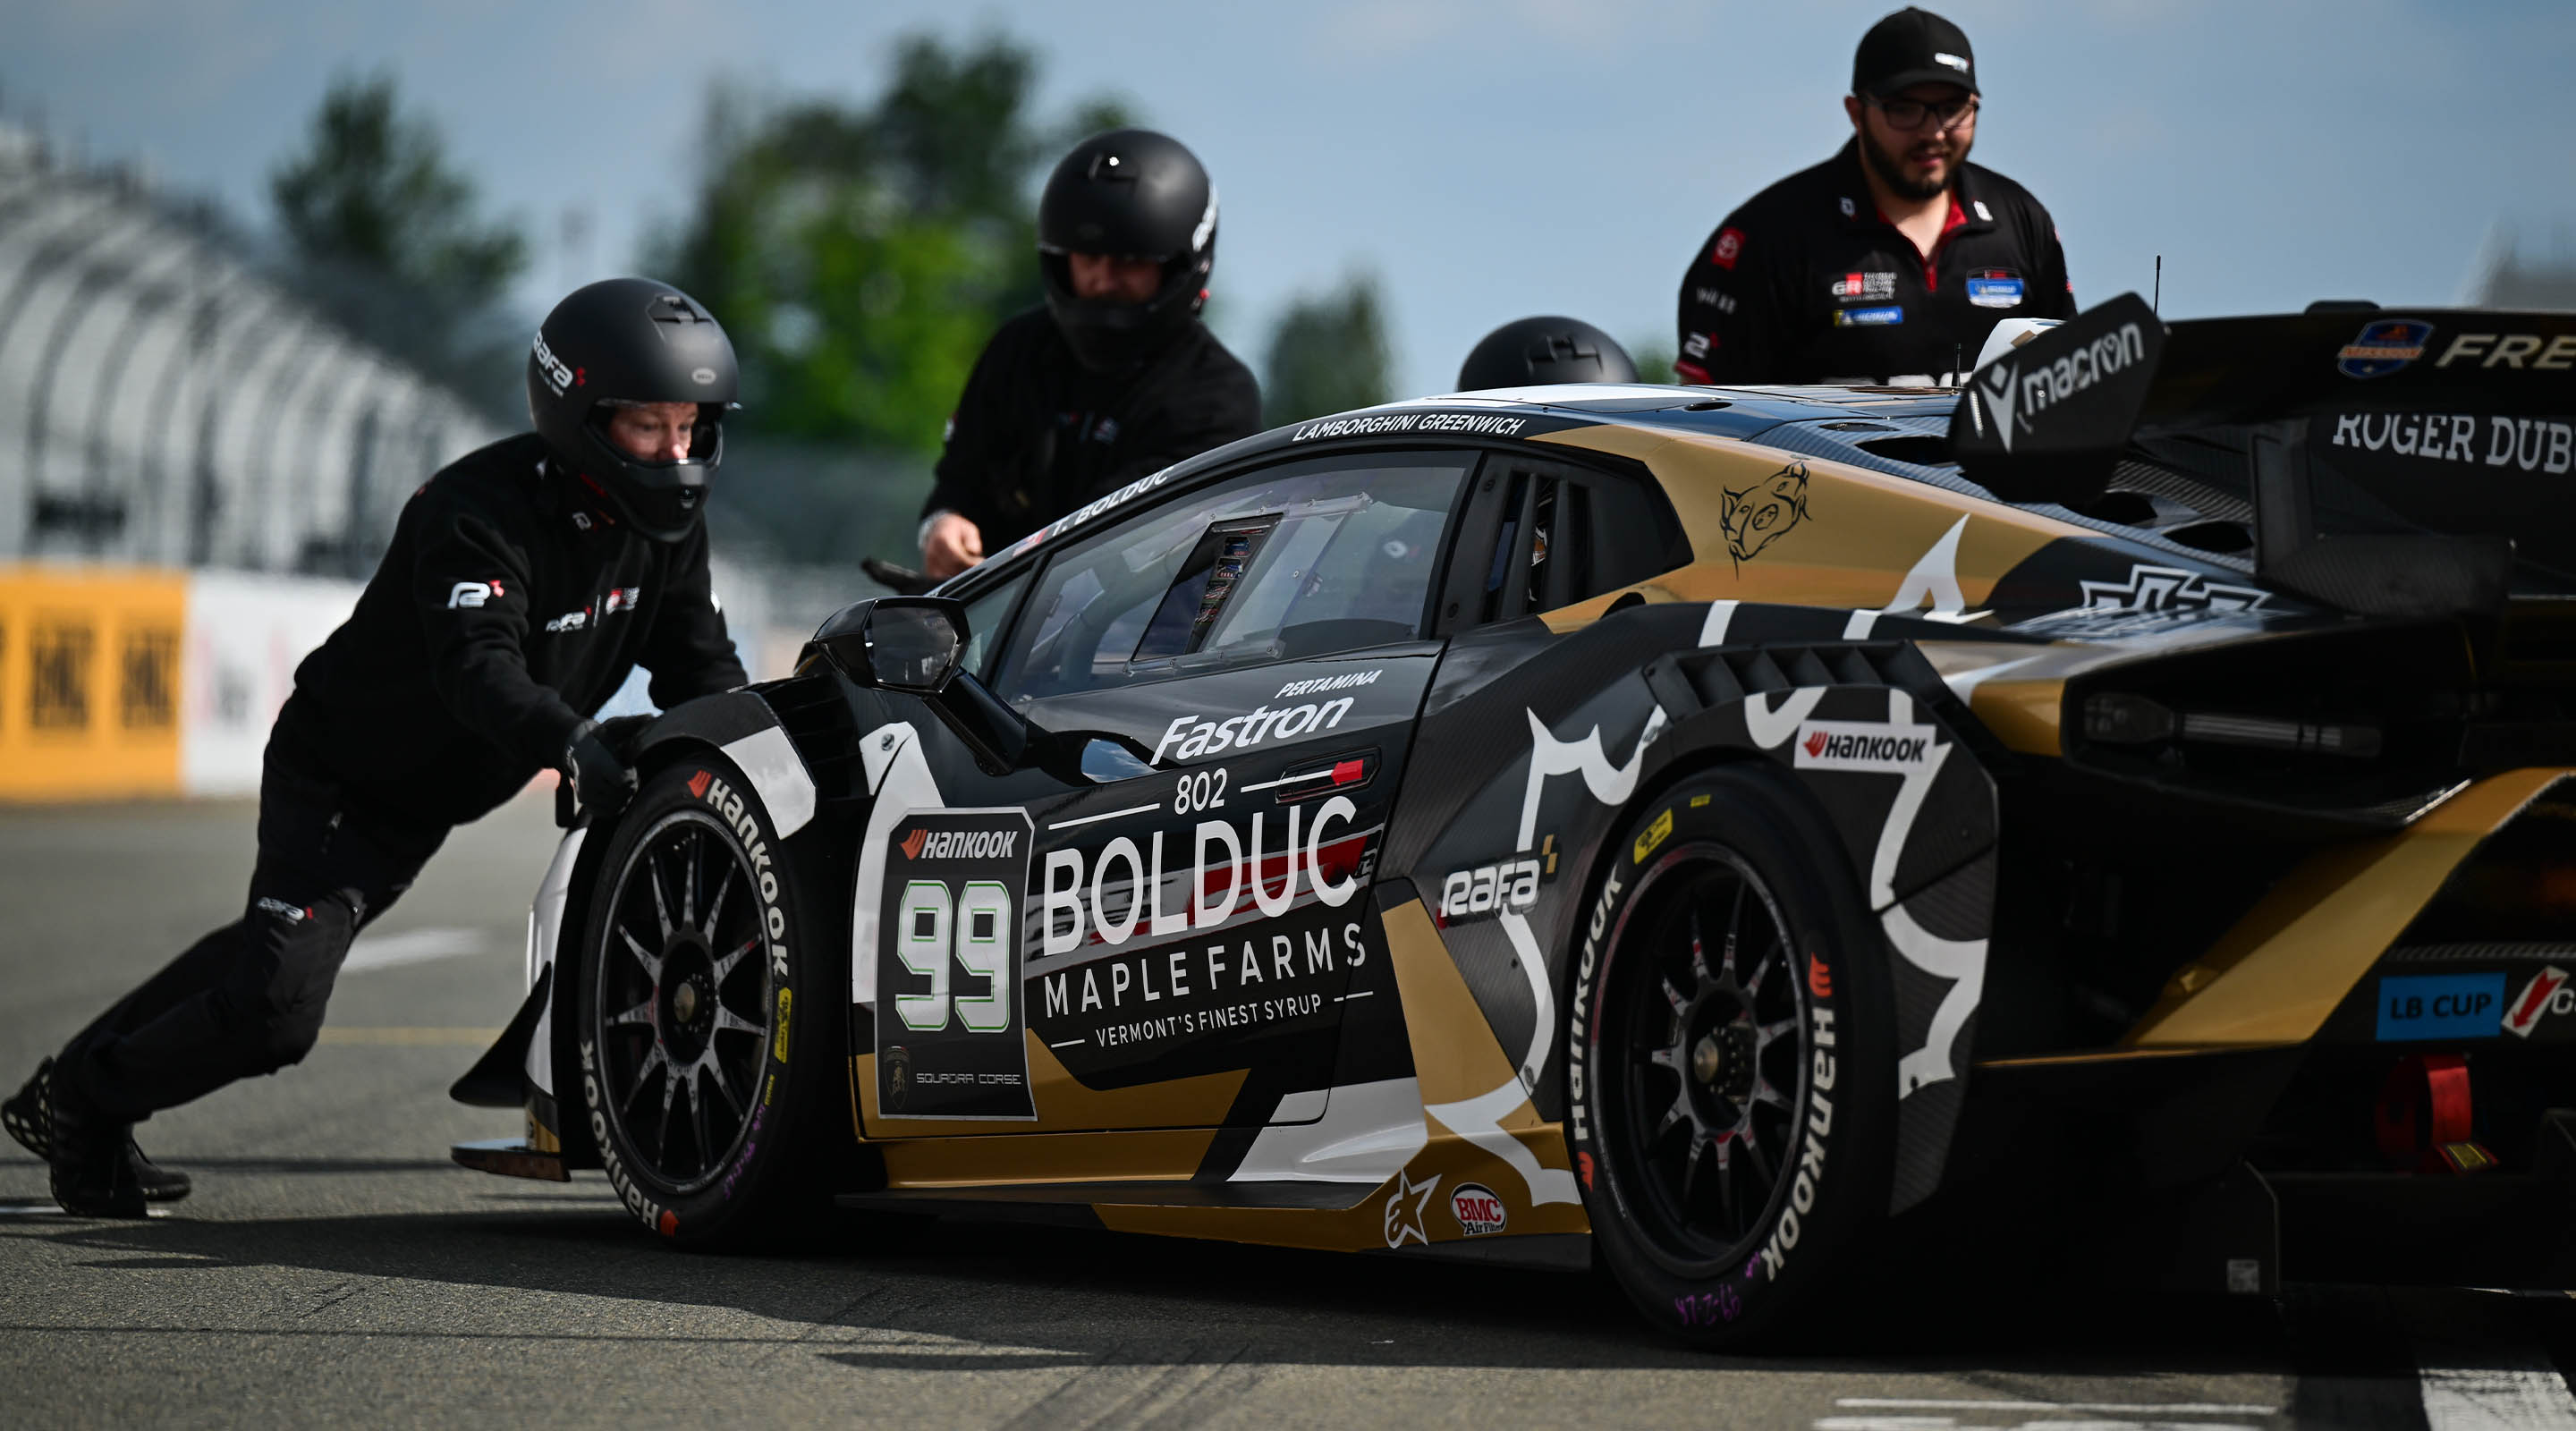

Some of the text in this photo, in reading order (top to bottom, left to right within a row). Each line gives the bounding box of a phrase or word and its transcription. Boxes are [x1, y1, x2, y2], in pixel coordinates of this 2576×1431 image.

[2022, 323, 2144, 415] macron
[1292, 412, 1526, 442] LAMBORGHINI GREENWICH
[2333, 415, 2576, 474] ROGER DUB
[1051, 465, 1174, 538] T. BOLDUC
[1275, 670, 1383, 699] PERTAMINA
[1149, 697, 1355, 766] Fastron
[1174, 767, 1228, 815] 802
[1044, 796, 1358, 955] BOLDUC
[895, 879, 1012, 1033] 99
[1045, 923, 1366, 1018] MAPLE FARMS
[1096, 994, 1322, 1047] VERMONT'S FINEST SYRUP
[2390, 992, 2493, 1020] LB CUP
[916, 1072, 1021, 1085] SQUADRA CORSE
[1455, 1197, 1502, 1223] BMC
[1464, 1221, 1485, 1235] Air
